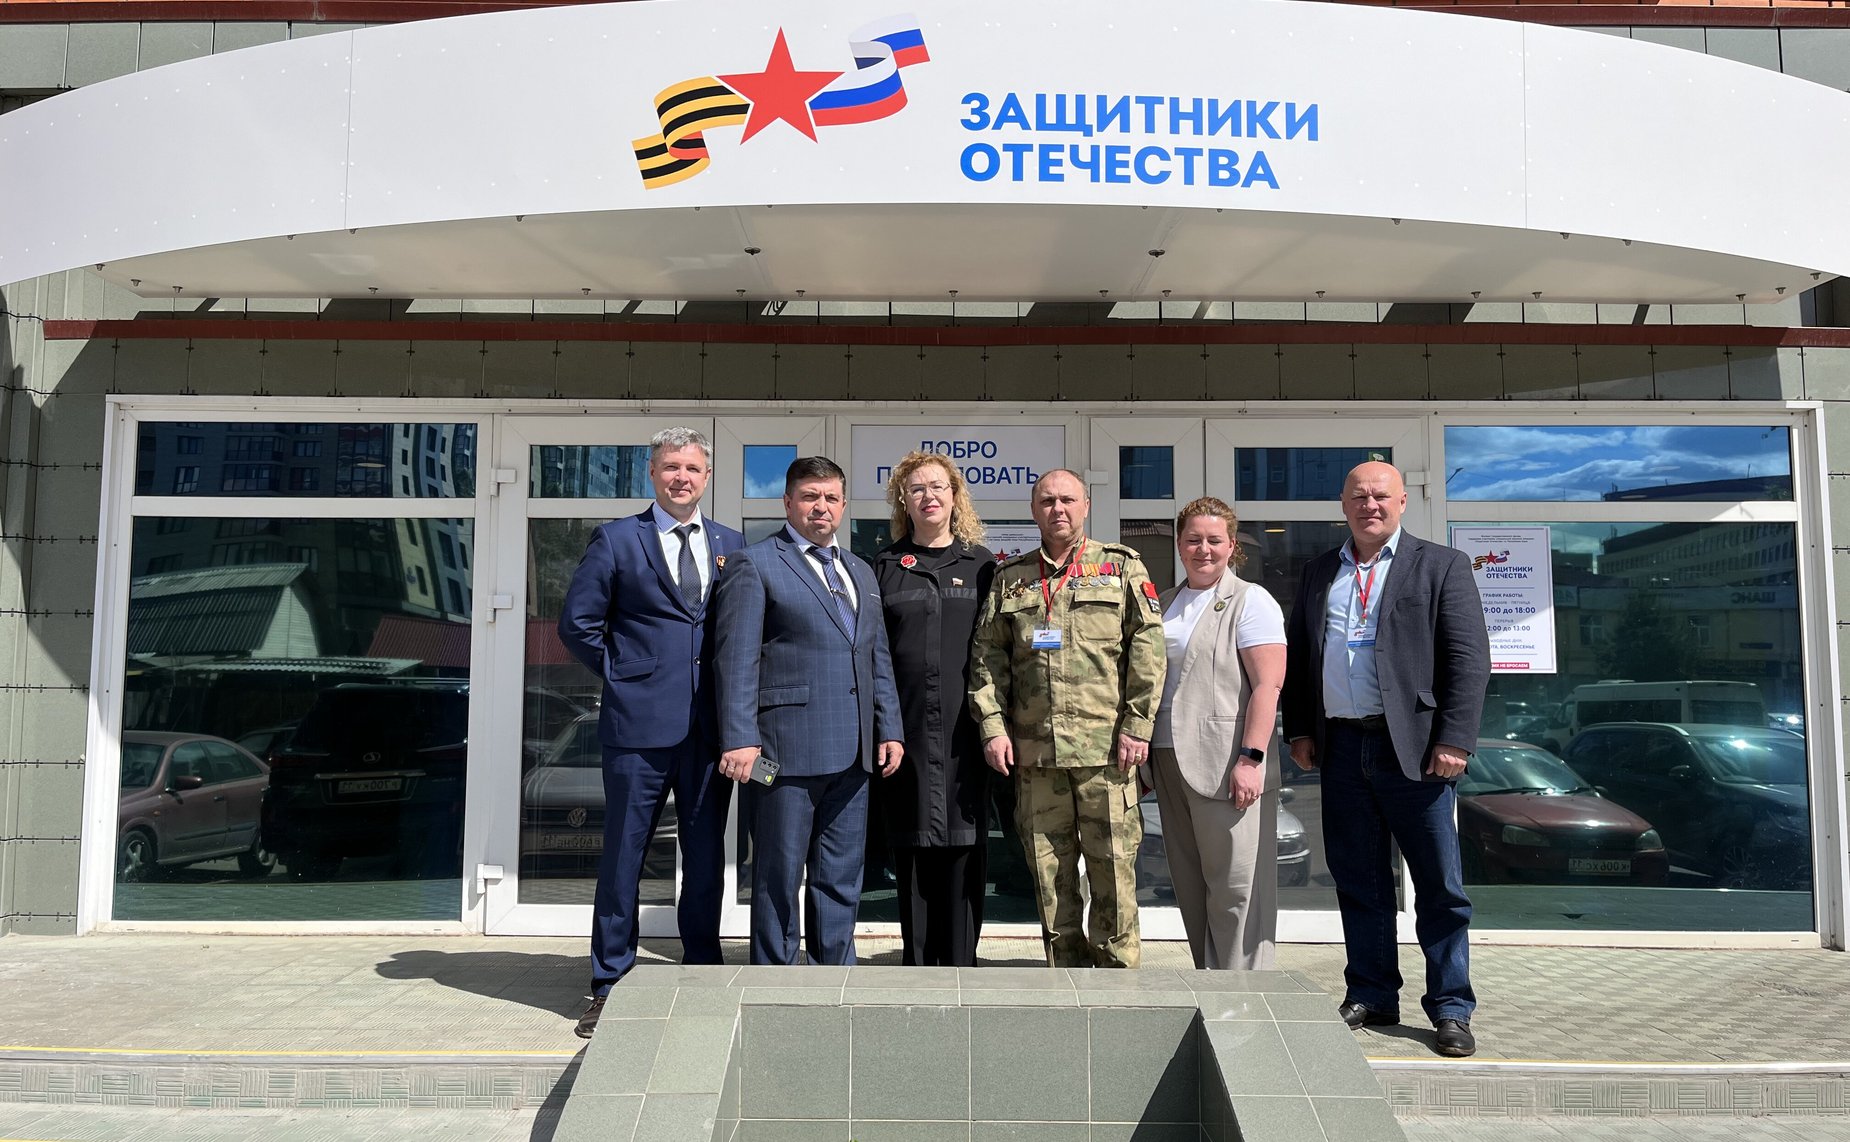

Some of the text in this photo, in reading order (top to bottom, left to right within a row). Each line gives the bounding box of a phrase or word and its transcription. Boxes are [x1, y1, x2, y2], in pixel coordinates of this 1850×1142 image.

[960, 92, 1318, 141] ЗАЩИТНИКИ
[960, 143, 1280, 189] ОТЕЧЕСТВА
[921, 440, 998, 459] ДОБРО
[876, 466, 1040, 485] ПОВАТЬ
[1514, 606, 1536, 614] 18:00
